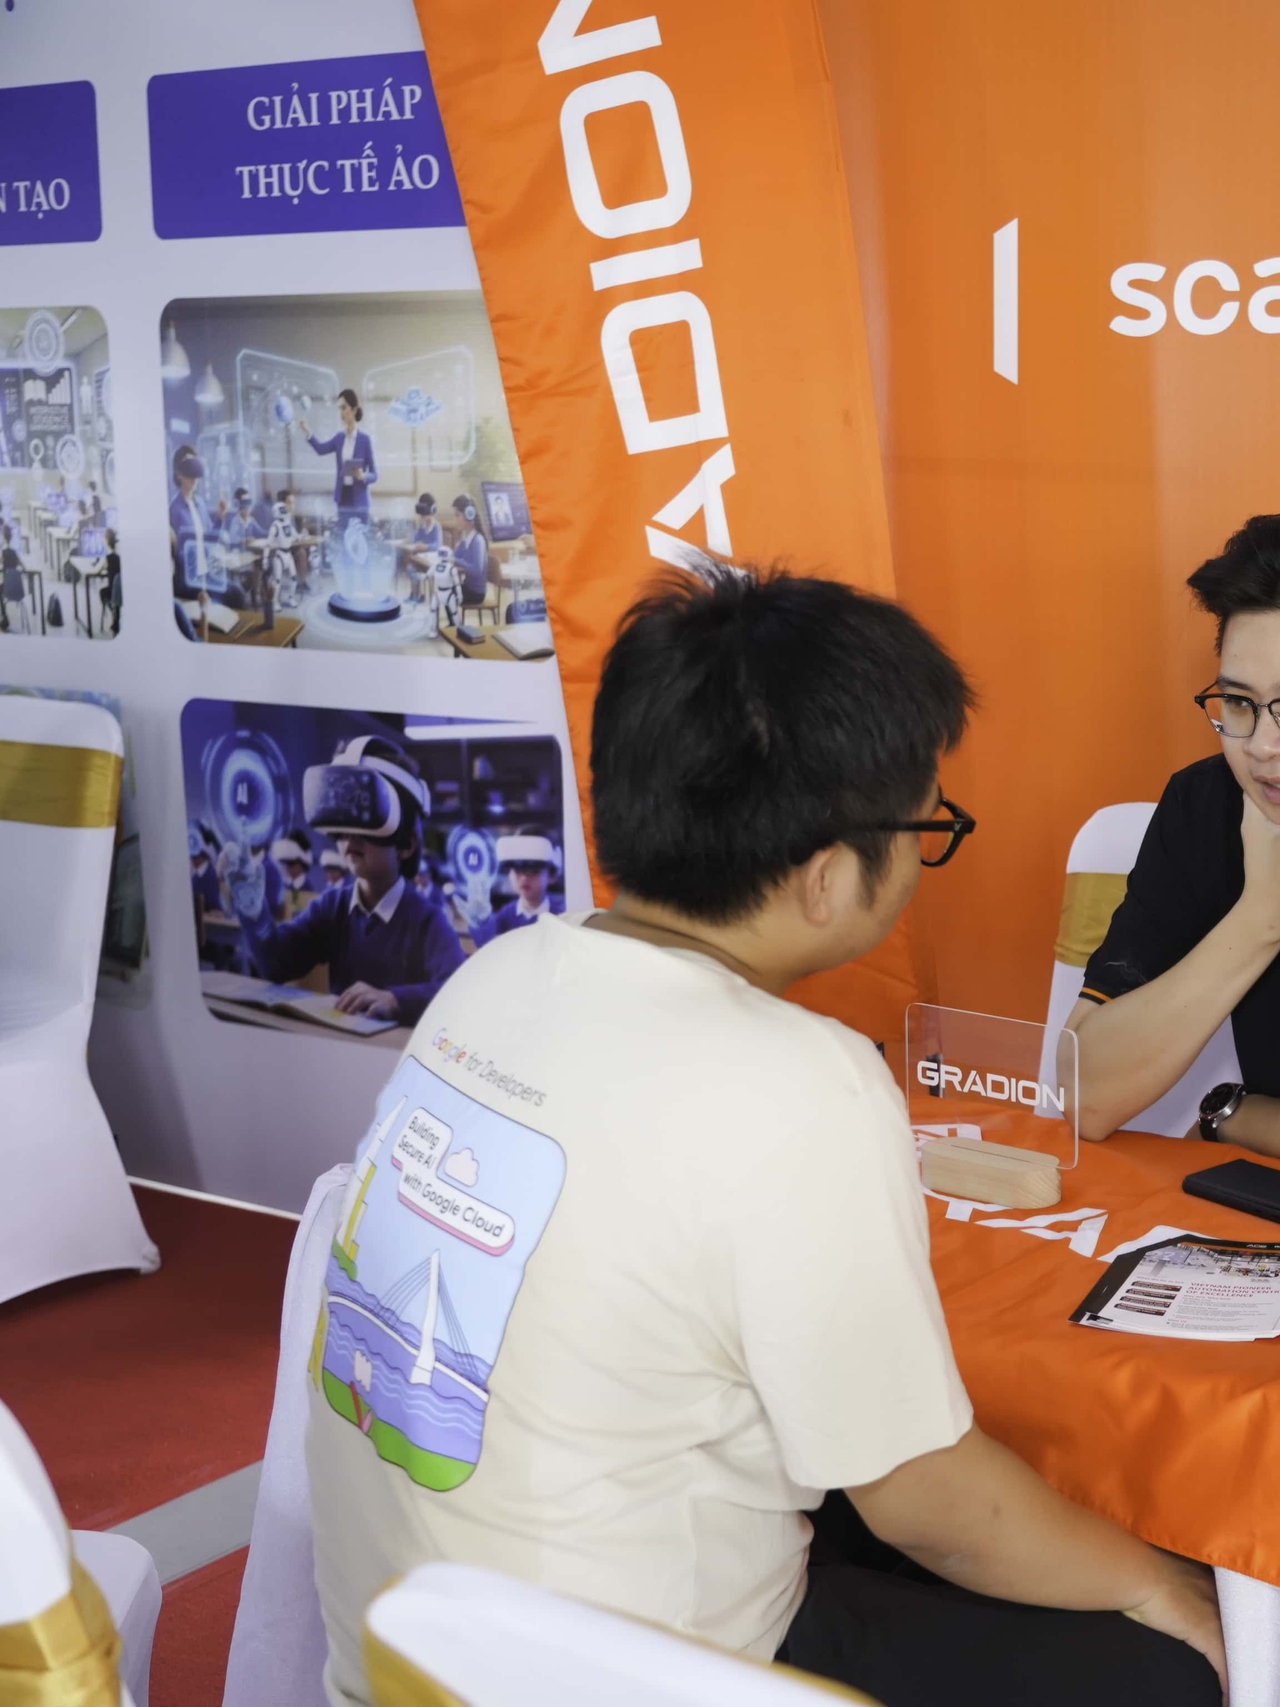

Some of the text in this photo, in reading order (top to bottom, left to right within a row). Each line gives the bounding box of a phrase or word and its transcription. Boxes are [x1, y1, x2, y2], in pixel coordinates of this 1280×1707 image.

[247, 77, 422, 131] GIẢI PHÁP
[235, 140, 440, 205] THỰC TẾ ẢO
[12, 178, 70, 220] TẠO
[431, 1027, 548, 1107] Google for Developers
[917, 1060, 1065, 1112] GRADION
[398, 1134, 437, 1169] Secure AI
[408, 1116, 440, 1150] Building
[403, 1171, 505, 1238] with Google Cloud
[1188, 1286, 1249, 1294] AUTOMATION
